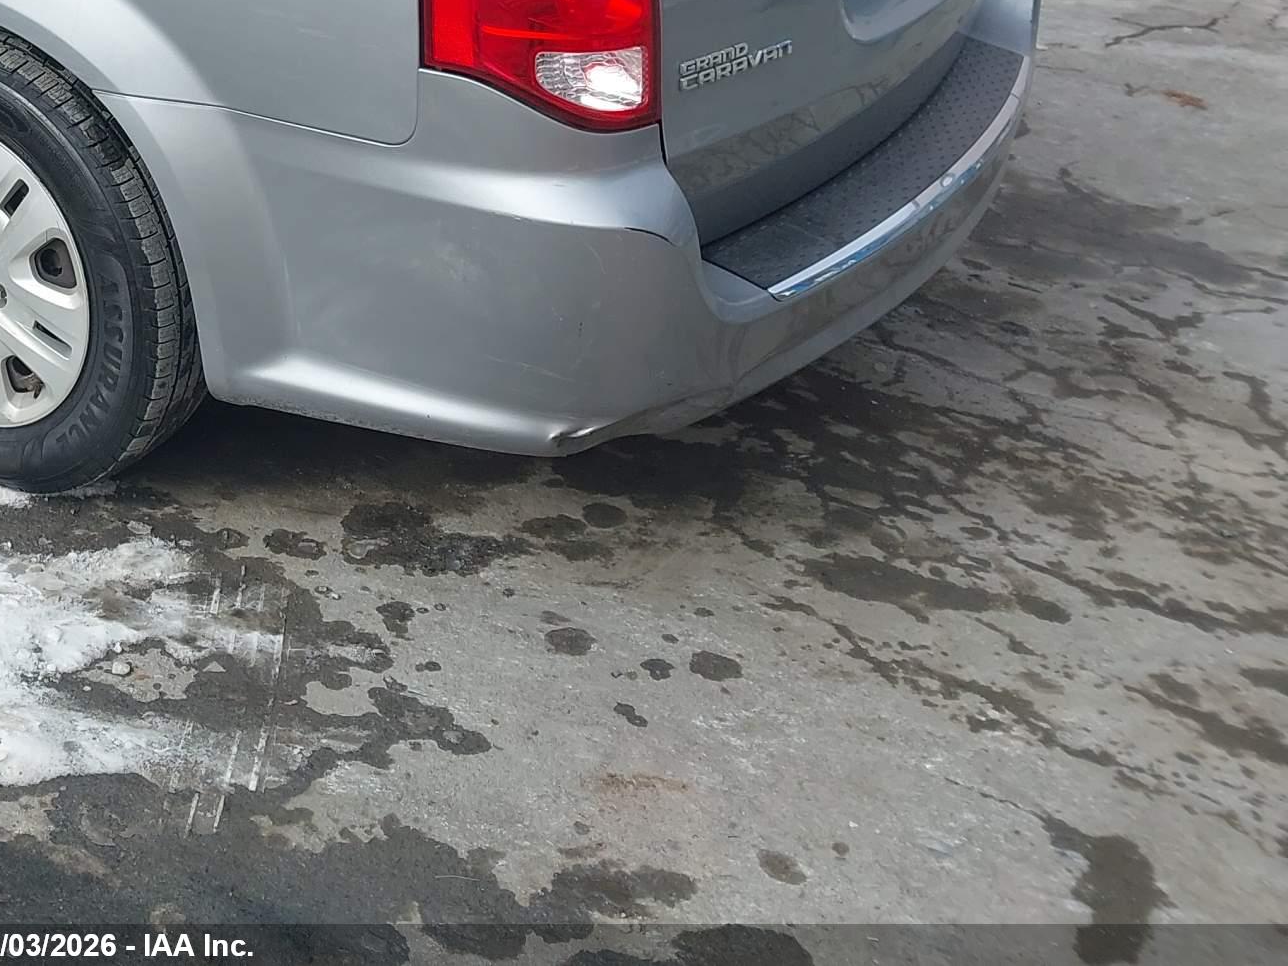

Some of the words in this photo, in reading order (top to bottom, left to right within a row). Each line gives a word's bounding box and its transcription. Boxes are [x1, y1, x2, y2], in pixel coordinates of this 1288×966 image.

[679, 42, 749, 76] GRAND
[679, 39, 793, 91] CARAVAN
[55, 274, 124, 445] ASSURANCE
